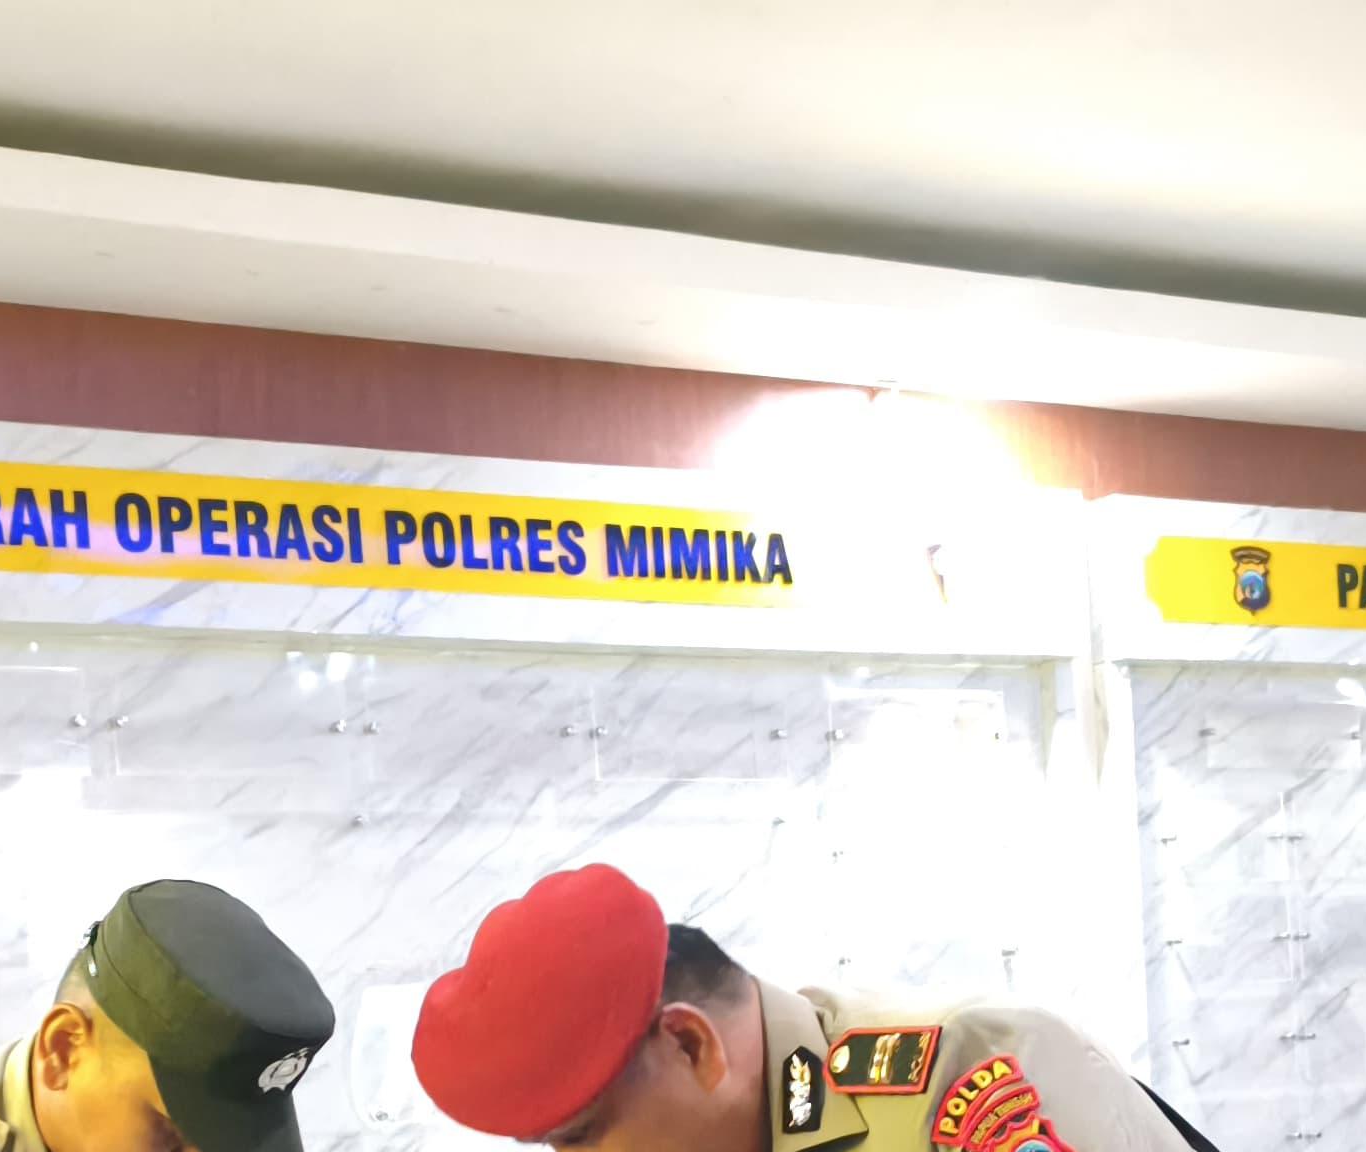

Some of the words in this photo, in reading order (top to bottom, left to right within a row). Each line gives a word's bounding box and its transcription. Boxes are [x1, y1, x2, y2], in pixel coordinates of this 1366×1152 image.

[114, 492, 364, 564] OPERASI
[384, 509, 587, 576] POLRES
[604, 523, 794, 585] MIMIKA
[938, 1059, 1013, 1136] POLDA
